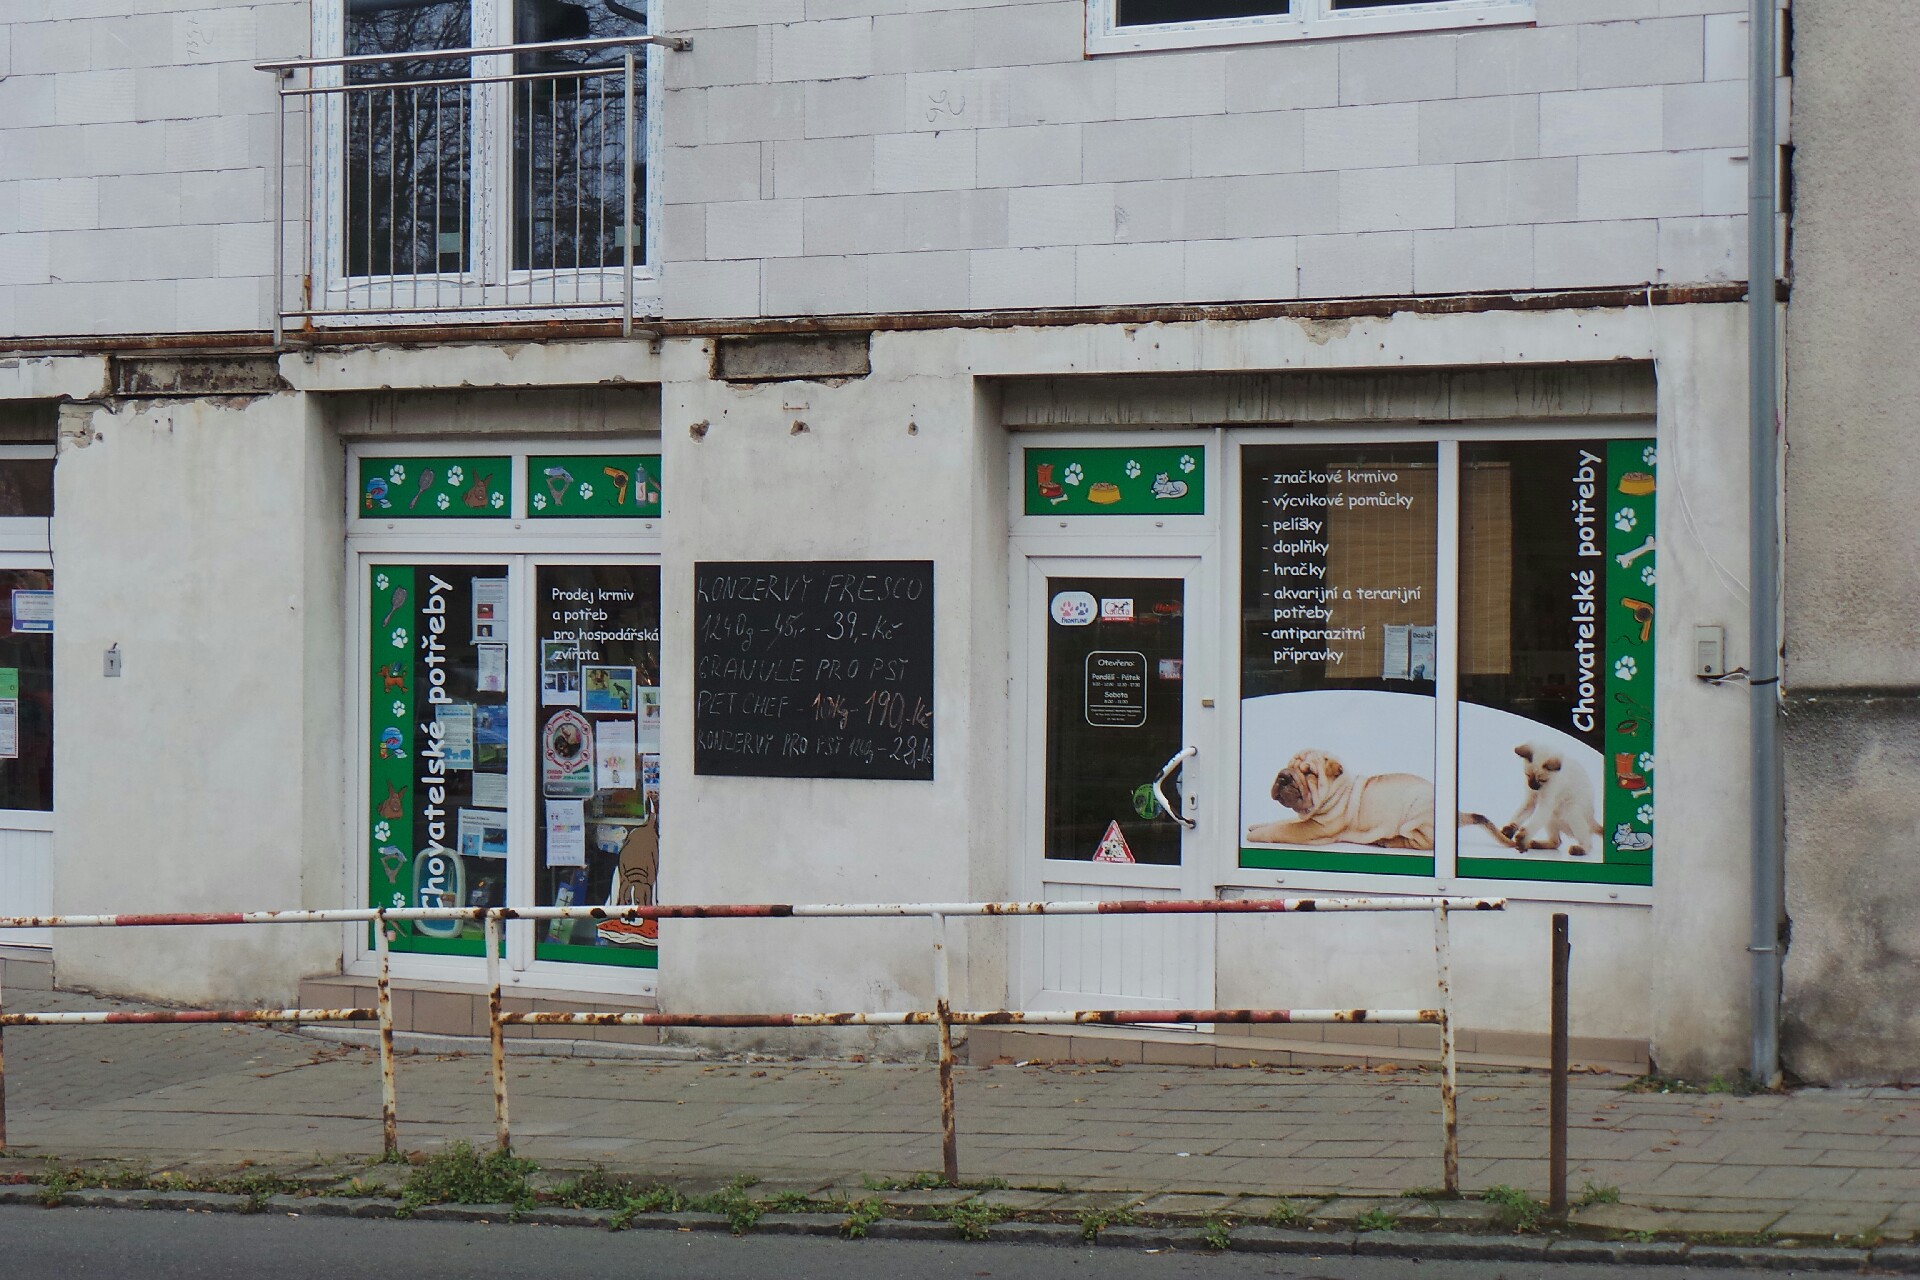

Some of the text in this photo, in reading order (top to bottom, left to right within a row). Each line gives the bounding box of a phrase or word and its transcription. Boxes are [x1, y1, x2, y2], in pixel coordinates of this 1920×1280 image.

[1273, 470, 1343, 484] značkové
[1347, 470, 1398, 484] krmivo
[1273, 493, 1344, 511] výcvikové
[1348, 491, 1413, 510] pomůcky
[1273, 517, 1323, 535] pelíšky
[1273, 539, 1329, 558] doplňky
[1273, 562, 1327, 580] hračky
[551, 587, 635, 605] Prodej krmiv
[697, 574, 923, 603] KONZERVY FRESCO
[1274, 586, 1338, 604] akvarijní
[1342, 590, 1352, 600] a
[1356, 586, 1421, 604] terarijní
[1571, 449, 1602, 732] Chovatelské potřeby
[552, 607, 608, 624] a potřeb
[1273, 606, 1333, 622] potřeby
[421, 574, 454, 705] potřeby
[553, 627, 659, 645] pro hospodářská
[1271, 626, 1366, 643] antiparazitní
[554, 647, 600, 661] zvířata
[1273, 646, 1344, 665] přípravky
[698, 657, 805, 682] GRANULE
[816, 658, 859, 681] PRO
[697, 730, 774, 756] KONZERVY
[782, 732, 808, 757] PRO
